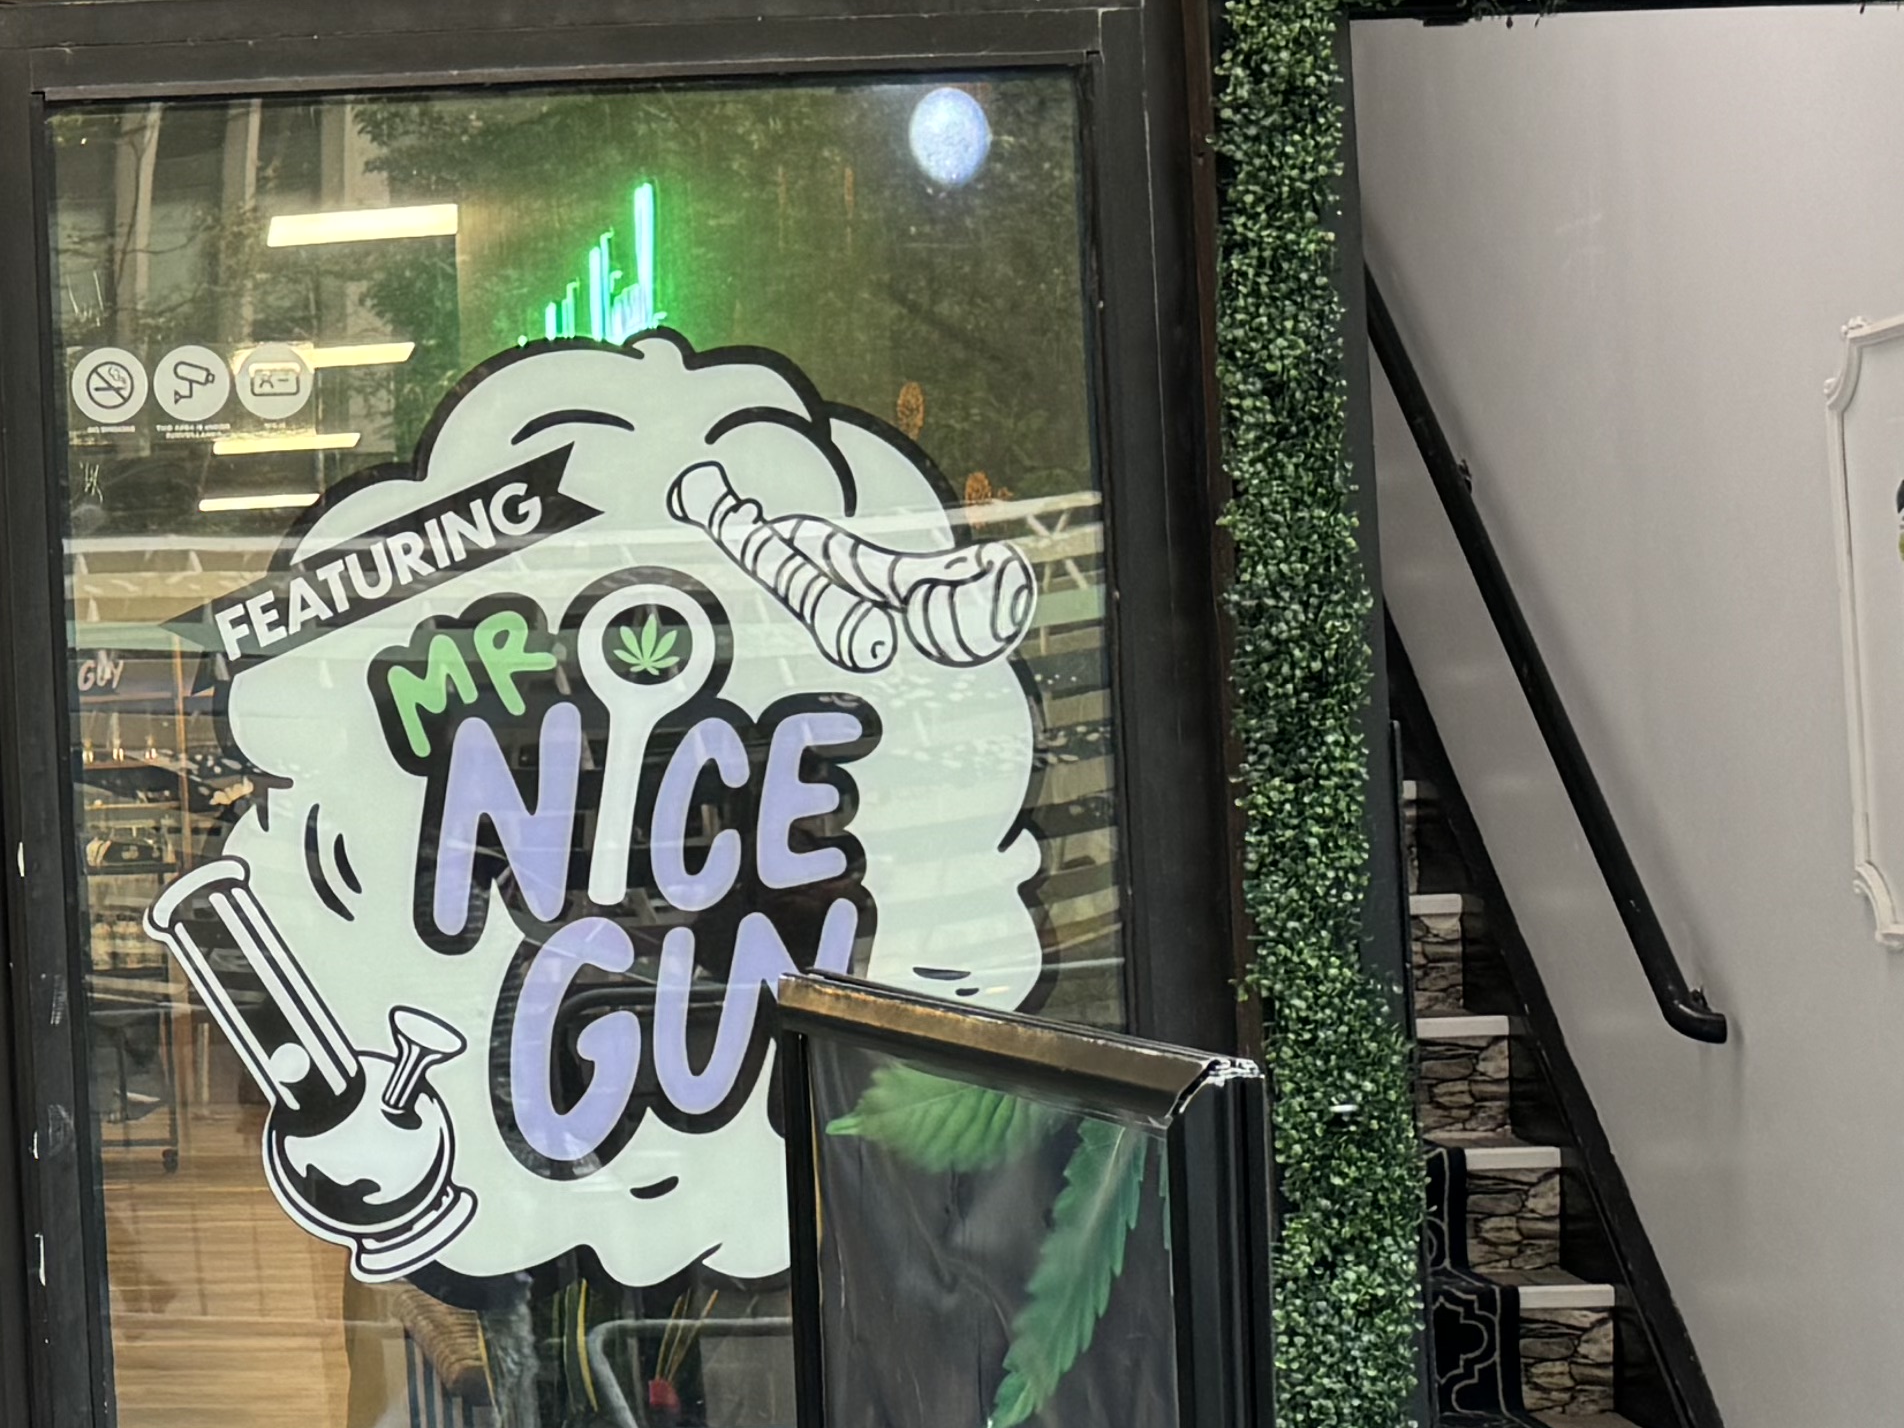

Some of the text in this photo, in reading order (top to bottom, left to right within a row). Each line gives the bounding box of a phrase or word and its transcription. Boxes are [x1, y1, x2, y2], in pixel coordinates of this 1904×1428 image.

[214, 482, 542, 661] FEATURING
[387, 611, 558, 758] MR
[432, 584, 863, 936] NICE
